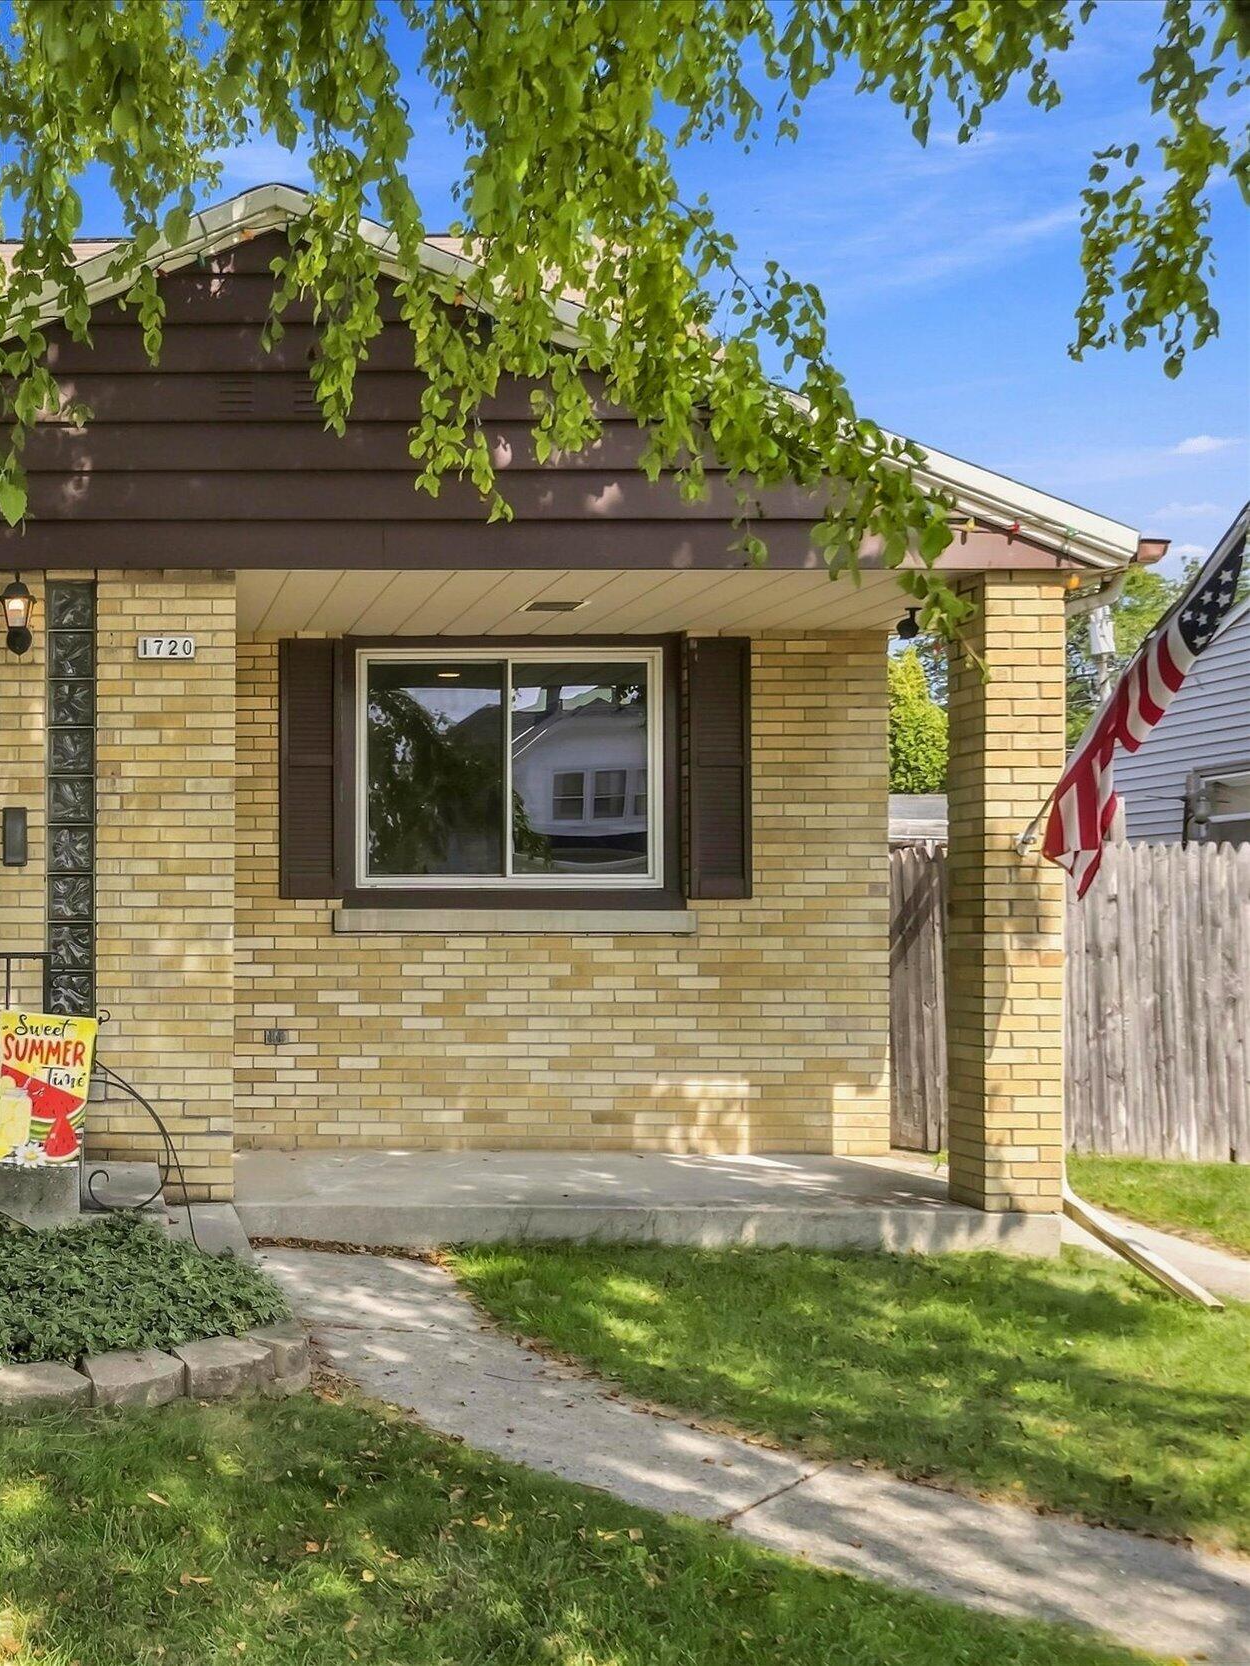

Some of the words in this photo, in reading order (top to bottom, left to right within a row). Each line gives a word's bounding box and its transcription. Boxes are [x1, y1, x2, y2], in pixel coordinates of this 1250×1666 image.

[143, 639, 192, 655] 1720
[14, 1014, 78, 1038] Sweet
[3, 1033, 87, 1067] SUMMER
